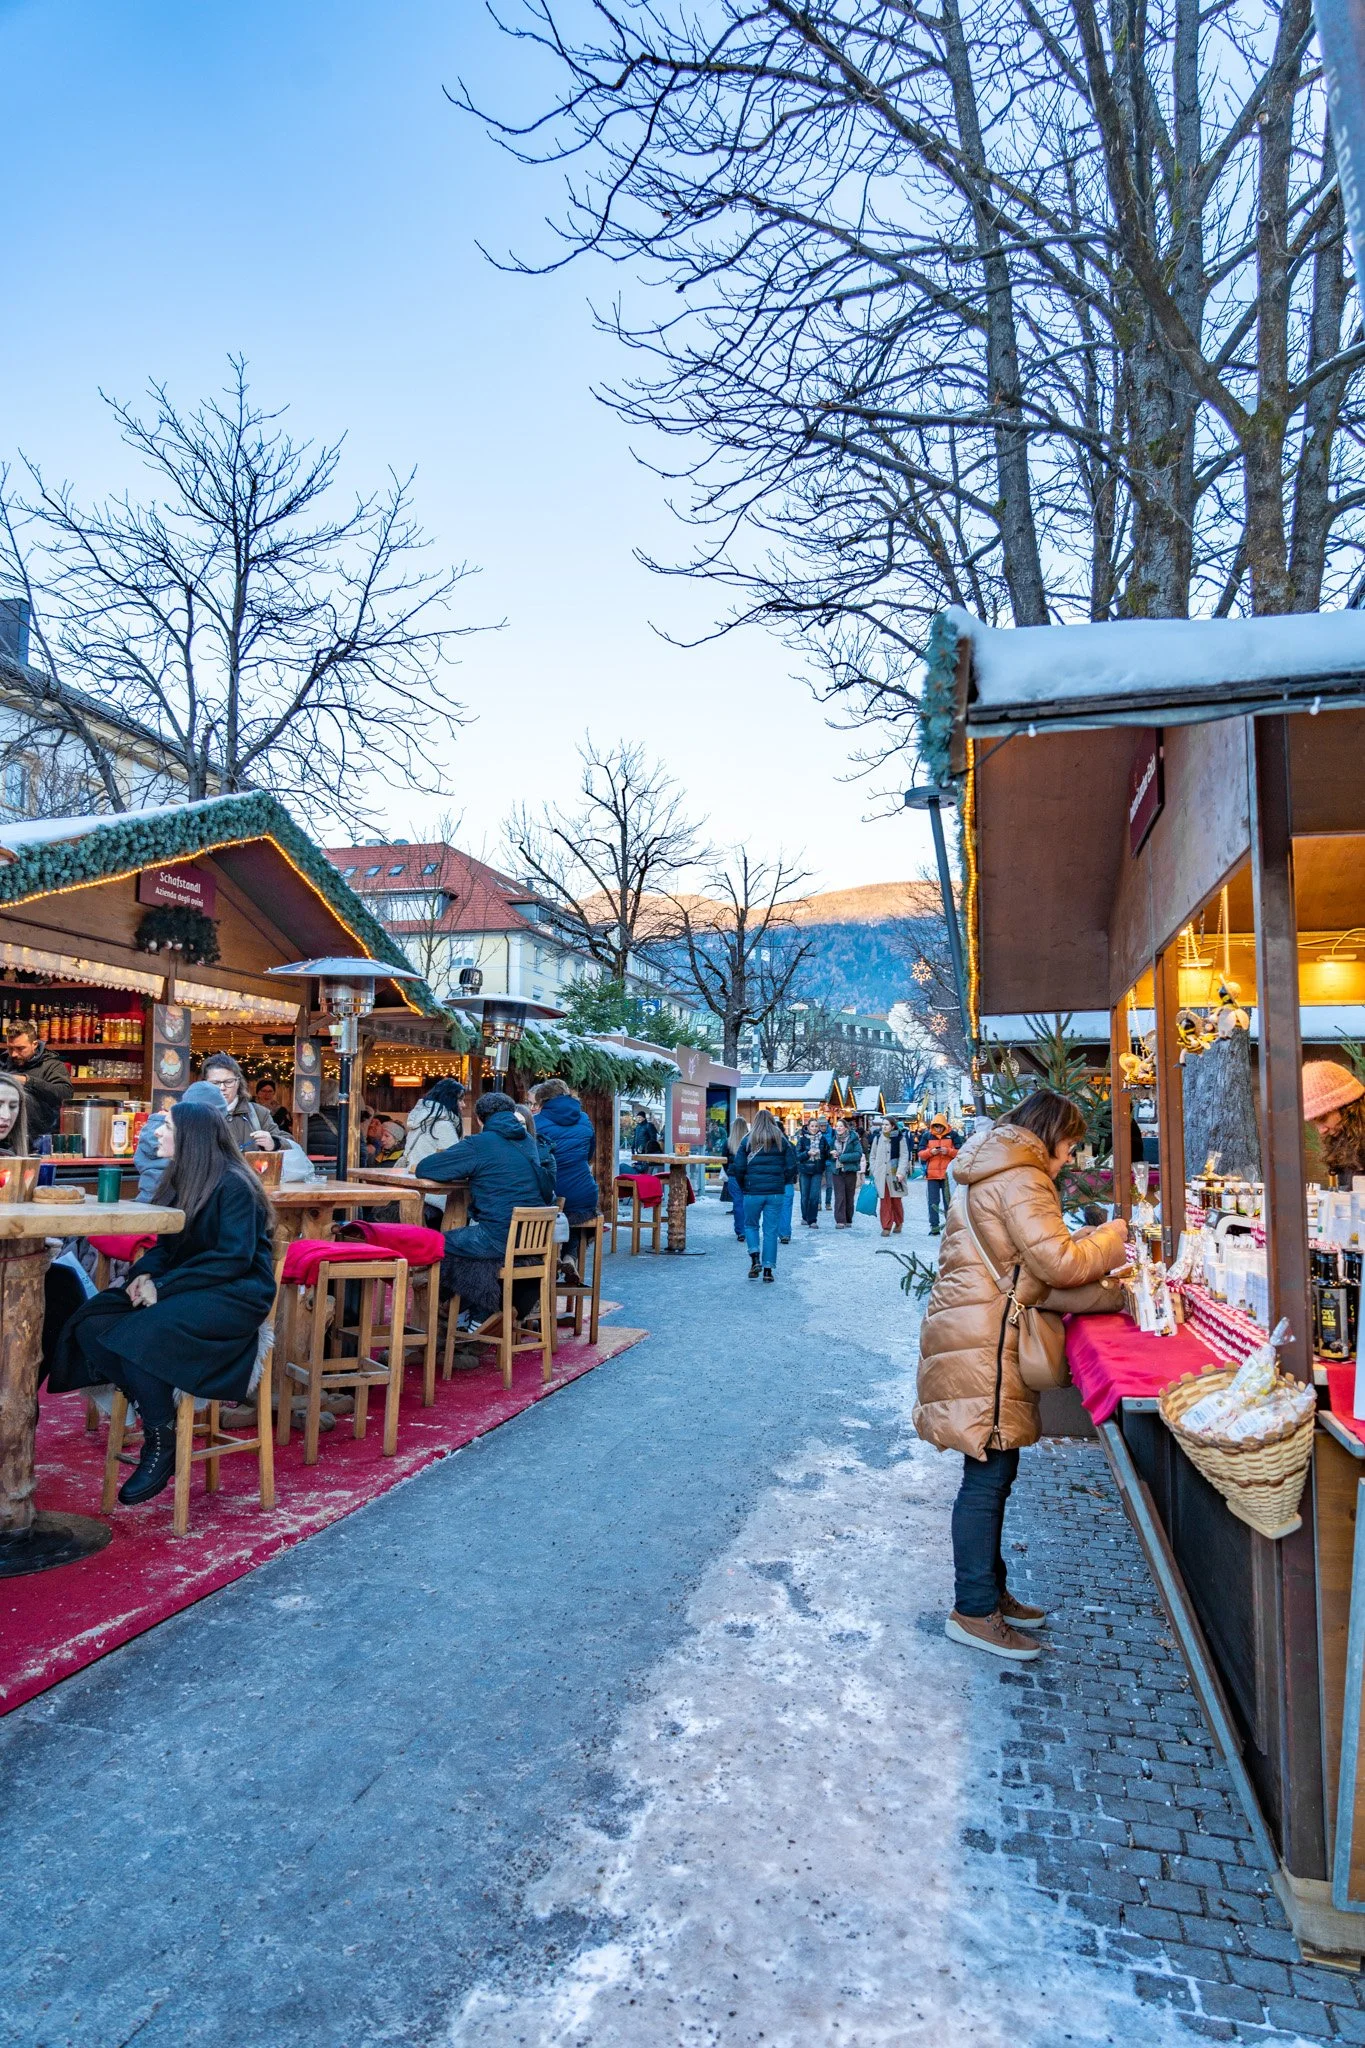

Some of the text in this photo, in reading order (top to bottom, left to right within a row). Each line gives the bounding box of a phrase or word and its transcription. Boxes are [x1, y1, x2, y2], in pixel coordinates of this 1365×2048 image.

[160, 871, 201, 893] Schafstandl
[155, 886, 177, 899] Azienda
[177, 893, 191, 904] degli
